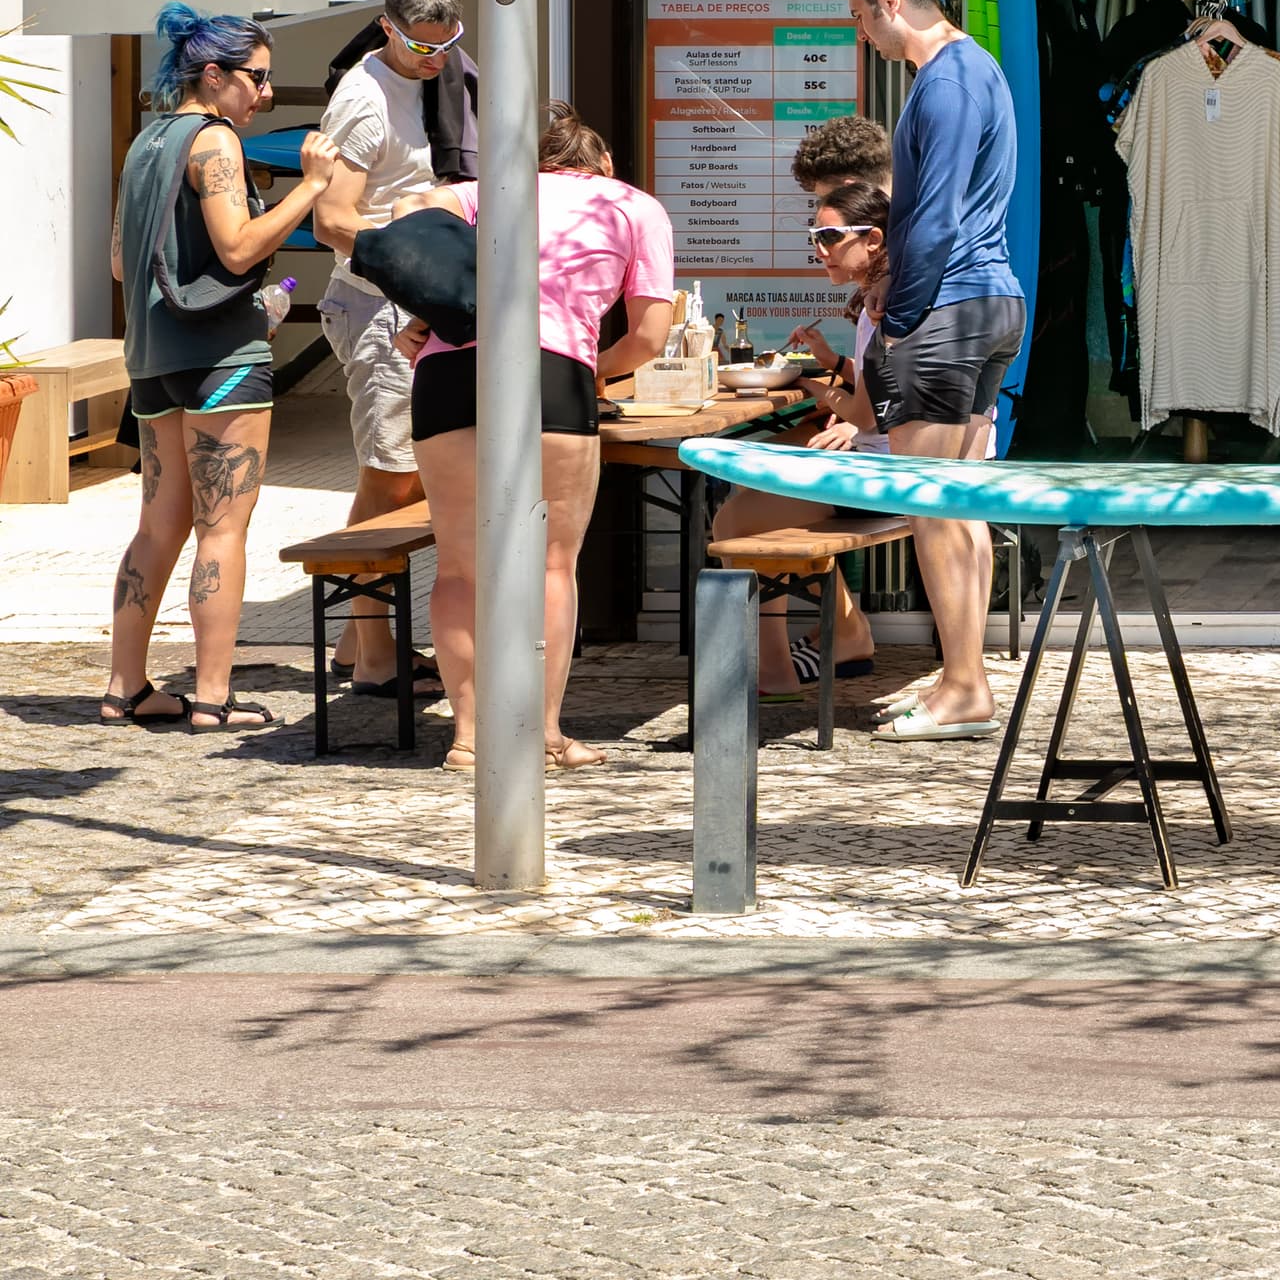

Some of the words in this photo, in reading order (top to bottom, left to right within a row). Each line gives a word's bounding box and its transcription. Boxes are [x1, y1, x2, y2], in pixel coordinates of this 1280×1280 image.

[661, 3, 704, 13] TABELA
[707, 3, 722, 13] DE
[725, 3, 770, 15] PREÇOS
[786, 3, 844, 13] PRICELIST
[686, 50, 710, 59] Aulas
[711, 50, 722, 59] de
[724, 50, 742, 59] surf
[803, 54, 828, 63] 40€
[688, 58, 706, 67] Surf
[707, 58, 738, 67] lessons
[674, 77, 712, 85] Passeios
[714, 77, 738, 85] stand
[740, 78, 752, 88] up
[803, 81, 827, 90] 55€
[676, 86, 706, 94] Paddle
[712, 86, 731, 94] SUP
[732, 86, 750, 94] Tour
[692, 125, 736, 134] Softboard
[690, 144, 737, 153] Hardboard
[689, 162, 707, 171] SUP
[708, 162, 739, 171] Boards
[680, 181, 704, 190] Fatos
[711, 181, 747, 190] Wetsuits
[690, 199, 737, 209] Bodyboard
[687, 217, 740, 226] Skimboards
[687, 237, 741, 246] Skateboards
[673, 255, 714, 264] Bicicletas
[720, 255, 754, 265] Bicycles
[726, 292, 754, 303] MARCA
[755, 292, 766, 303] AS
[767, 292, 788, 303] TUAS
[789, 292, 815, 303] AULAS
[816, 292, 826, 303] DE
[827, 292, 848, 303] SURF
[746, 307, 768, 318] BOOK
[769, 307, 790, 318] YOUR
[791, 307, 812, 318] SURF
